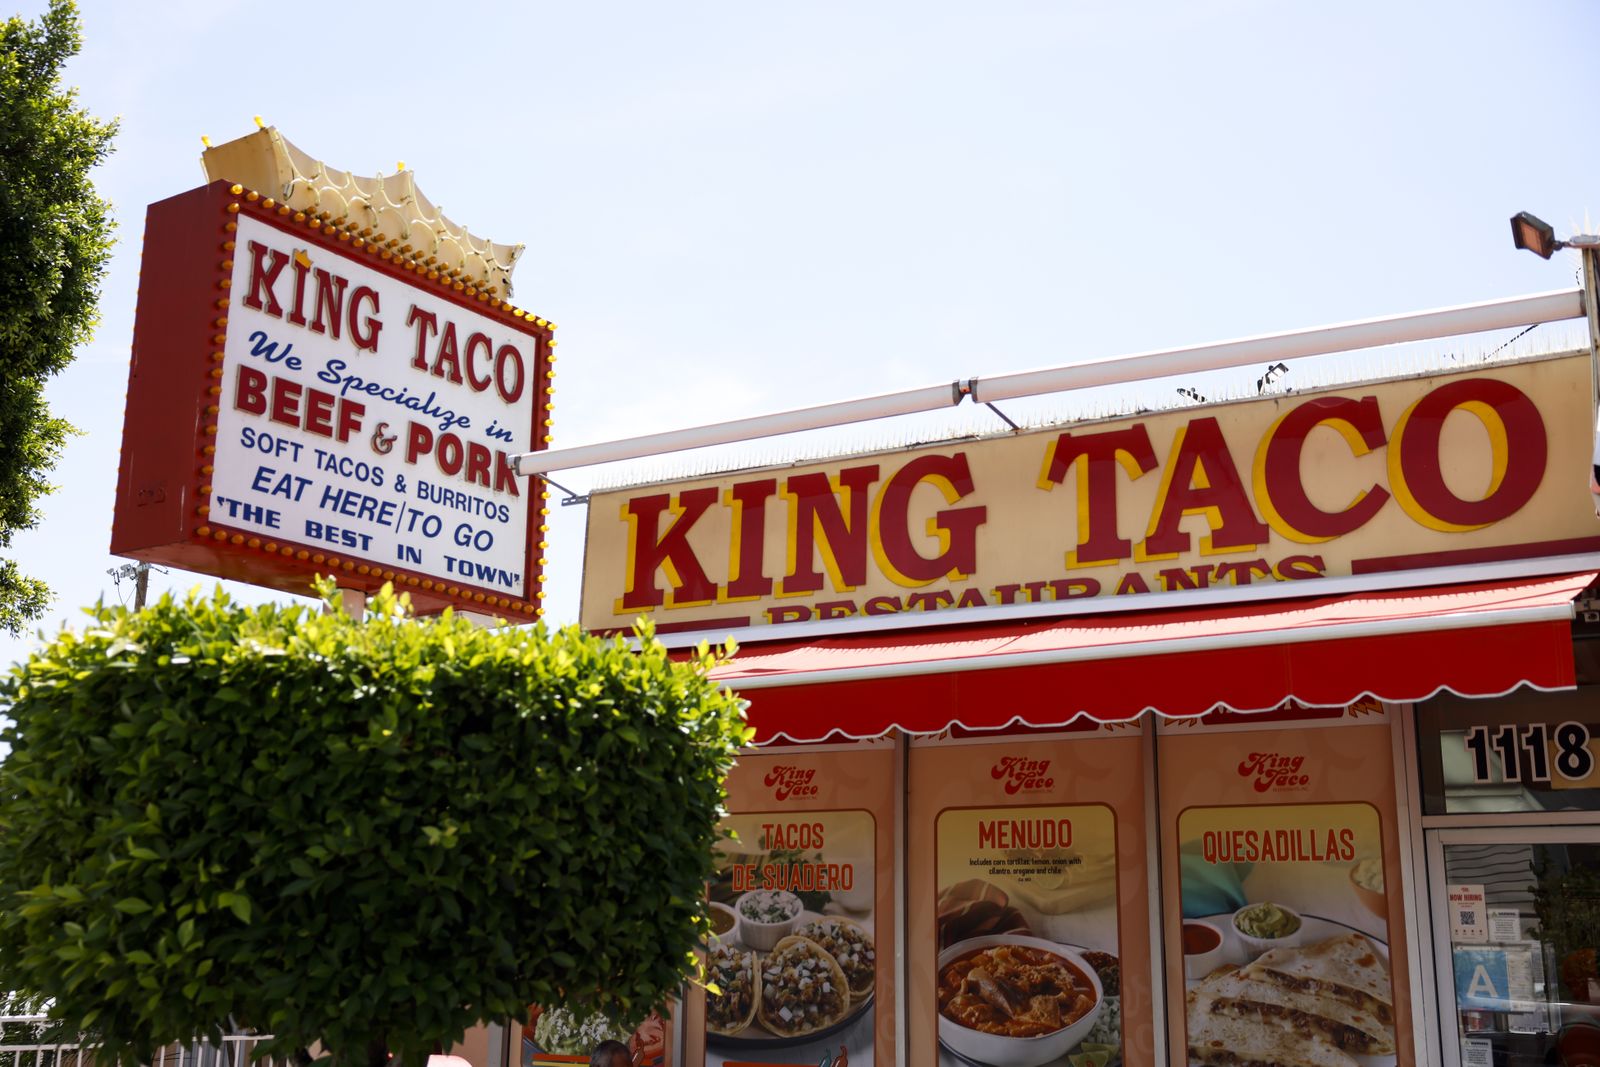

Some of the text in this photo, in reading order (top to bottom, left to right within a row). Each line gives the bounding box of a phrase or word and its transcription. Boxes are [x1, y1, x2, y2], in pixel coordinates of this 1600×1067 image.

[243, 240, 525, 404] KING TACO
[249, 331, 513, 442] We Specialize in
[234, 364, 520, 497] BEEF & PORK
[240, 427, 510, 523] SOFT TACOS & BURRITOS
[251, 466, 313, 501] EAT
[454, 523, 494, 551] GO
[614, 378, 1547, 615] KING TACO
[305, 520, 373, 551] BEST
[397, 544, 422, 564] IN
[1238, 752, 1305, 777] King
[1464, 720, 1594, 784] 1118
[764, 765, 816, 787] King
[991, 756, 1051, 779] King
[1253, 768, 1309, 792] Taco
[775, 780, 818, 801] Taco
[1005, 771, 1054, 795] Taco
[762, 823, 825, 850] TACOS
[978, 819, 1073, 849] MENUDO
[1203, 828, 1355, 864] QUESADILLAS
[969, 858, 992, 866] Includes
[1068, 857, 1081, 865] with
[1013, 868, 1035, 876] oregano
[732, 863, 854, 891] DE SUADERO
[1449, 894, 1483, 902] NOW HIRING
[1466, 964, 1499, 998] A
